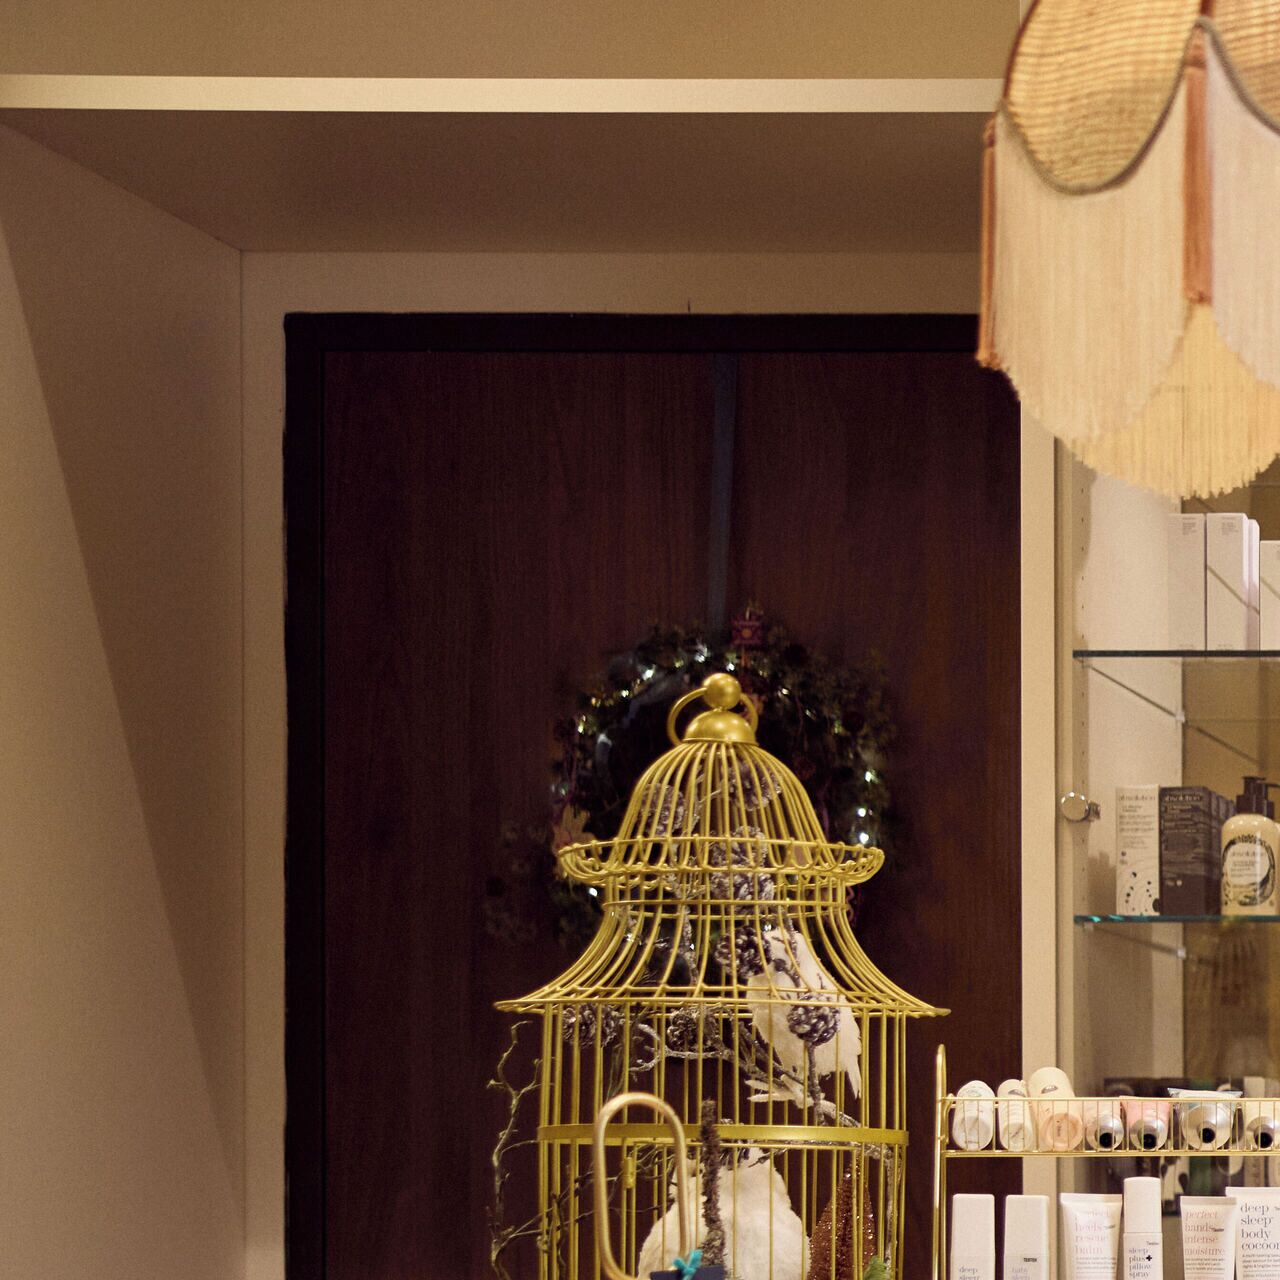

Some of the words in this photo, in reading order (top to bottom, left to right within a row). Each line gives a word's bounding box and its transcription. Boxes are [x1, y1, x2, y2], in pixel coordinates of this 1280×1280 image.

[1240, 1203, 1269, 1215] deep
[1185, 1210, 1218, 1221] perfect
[1240, 1215, 1272, 1227] sleep
[1241, 1228, 1271, 1240] body
[959, 1266, 978, 1275] deep
